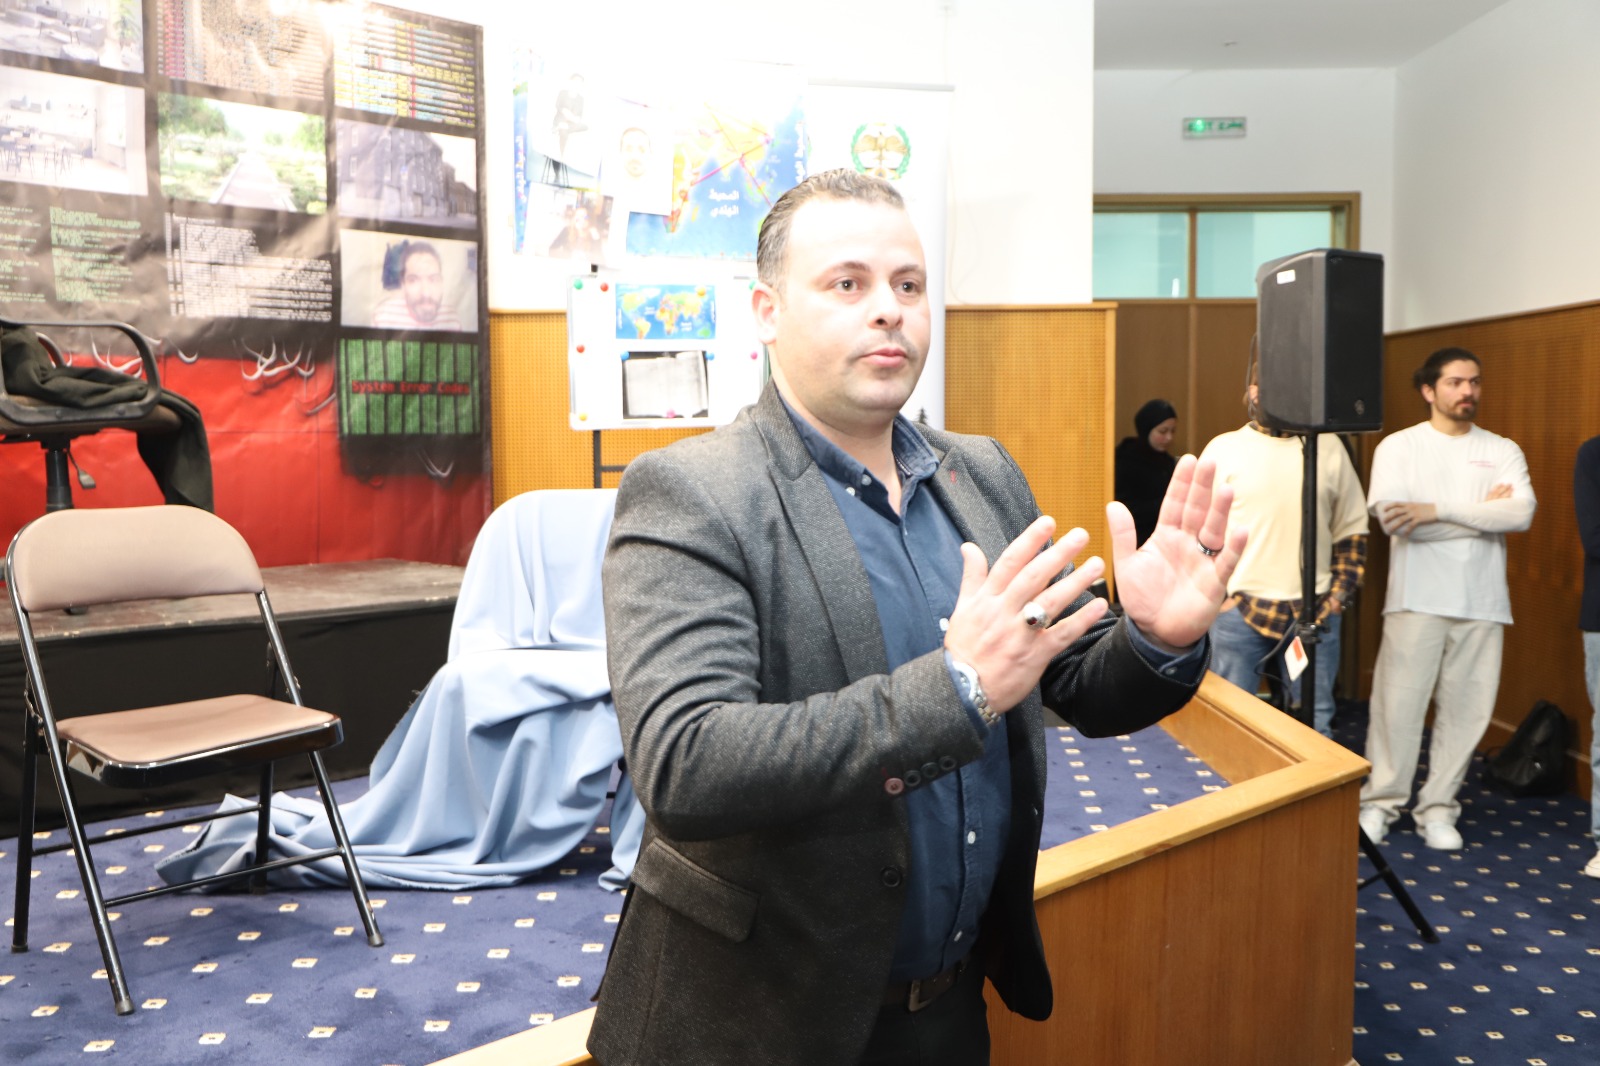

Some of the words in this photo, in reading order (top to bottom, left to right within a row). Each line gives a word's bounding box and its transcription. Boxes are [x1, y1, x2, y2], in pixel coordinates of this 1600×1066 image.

[1188, 121, 1213, 131] EIT
[708, 188, 740, 202] المحيط
[709, 204, 740, 218] الهندي
[352, 380, 395, 394] System
[400, 381, 432, 392] Error
[438, 382, 470, 394] Codes
